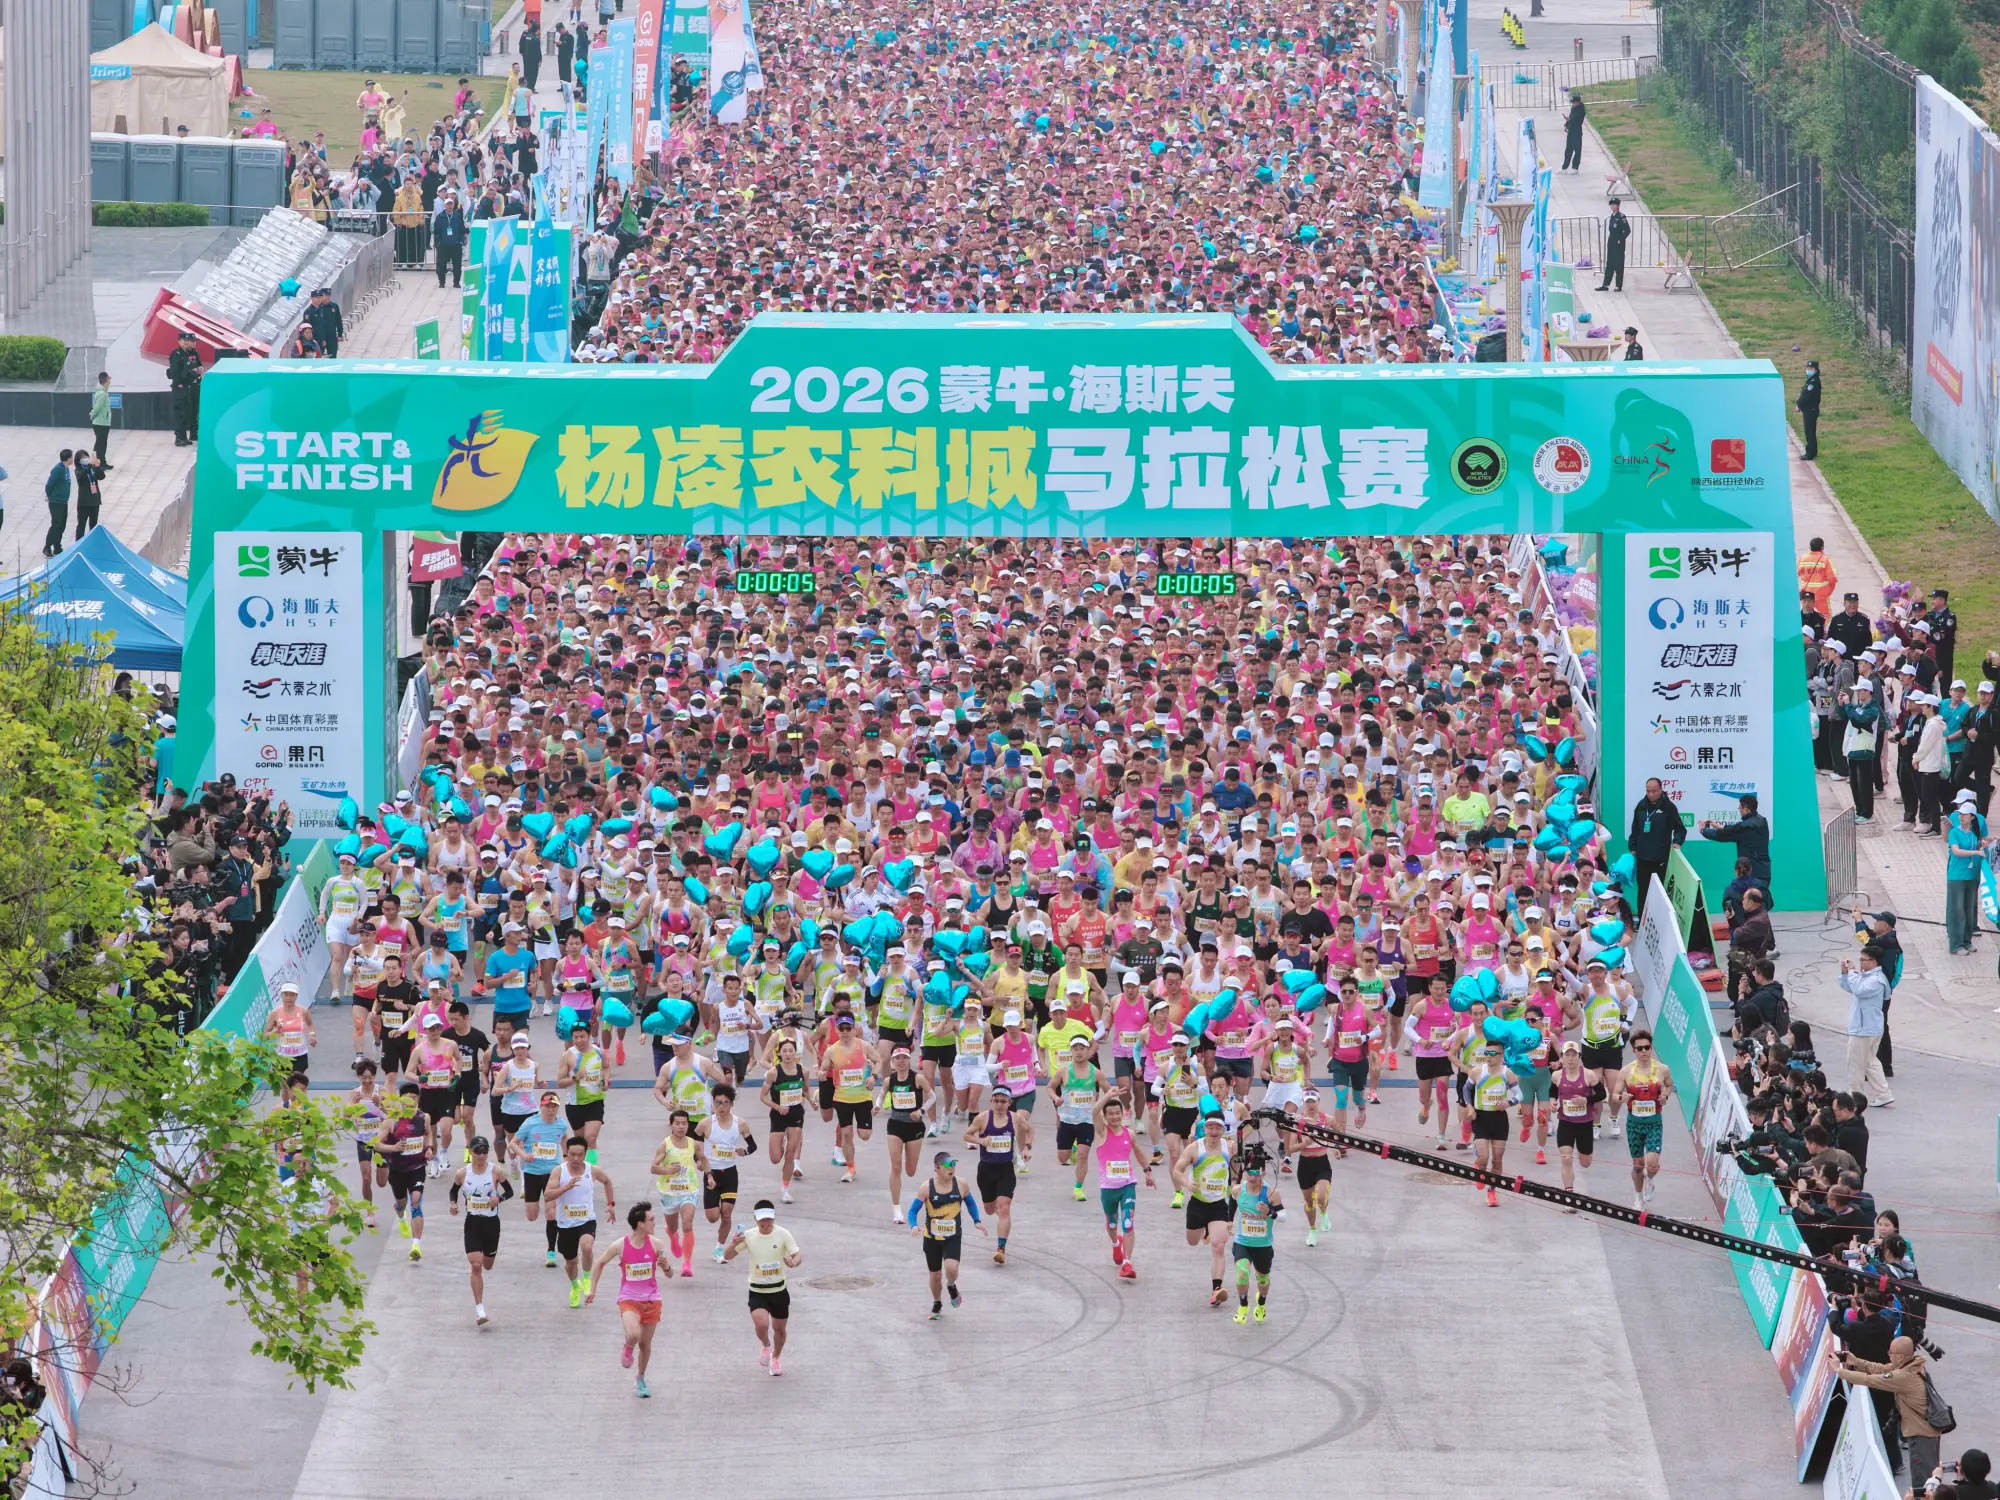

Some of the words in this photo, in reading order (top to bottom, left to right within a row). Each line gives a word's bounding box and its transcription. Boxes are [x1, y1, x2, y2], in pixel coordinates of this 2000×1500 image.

[750, 370, 929, 414] 2026
[938, 366, 1234, 414] 蒙牛·海斯夫
[555, 424, 1429, 510] 杨凌农科城马拉松赛
[1614, 455, 1649, 465] CHINA
[236, 464, 412, 491] FINISH
[1691, 476, 1765, 486] 陕西省田径协会
[277, 545, 339, 577] 蒙牛
[1688, 547, 1750, 577] 蒙牛
[737, 572, 813, 592] 0:00:05
[1158, 574, 1234, 594] 0:00:05
[282, 598, 340, 615] 海斯夫
[1693, 599, 1751, 615] 海斯夫
[251, 642, 327, 667] 勇闯天涯
[1661, 644, 1737, 668] 勇闯天涯
[280, 680, 332, 697] 大秦之水
[1690, 682, 1742, 698] 大秦之水
[266, 713, 339, 726] 中国体育彩票
[1675, 714, 1749, 727] 中国体育彩票
[288, 745, 324, 762] 果凡
[1698, 747, 1734, 763] 果凡
[300, 780, 347, 789] 宝矿力水特
[1709, 782, 1756, 791] 宝矿力水特
